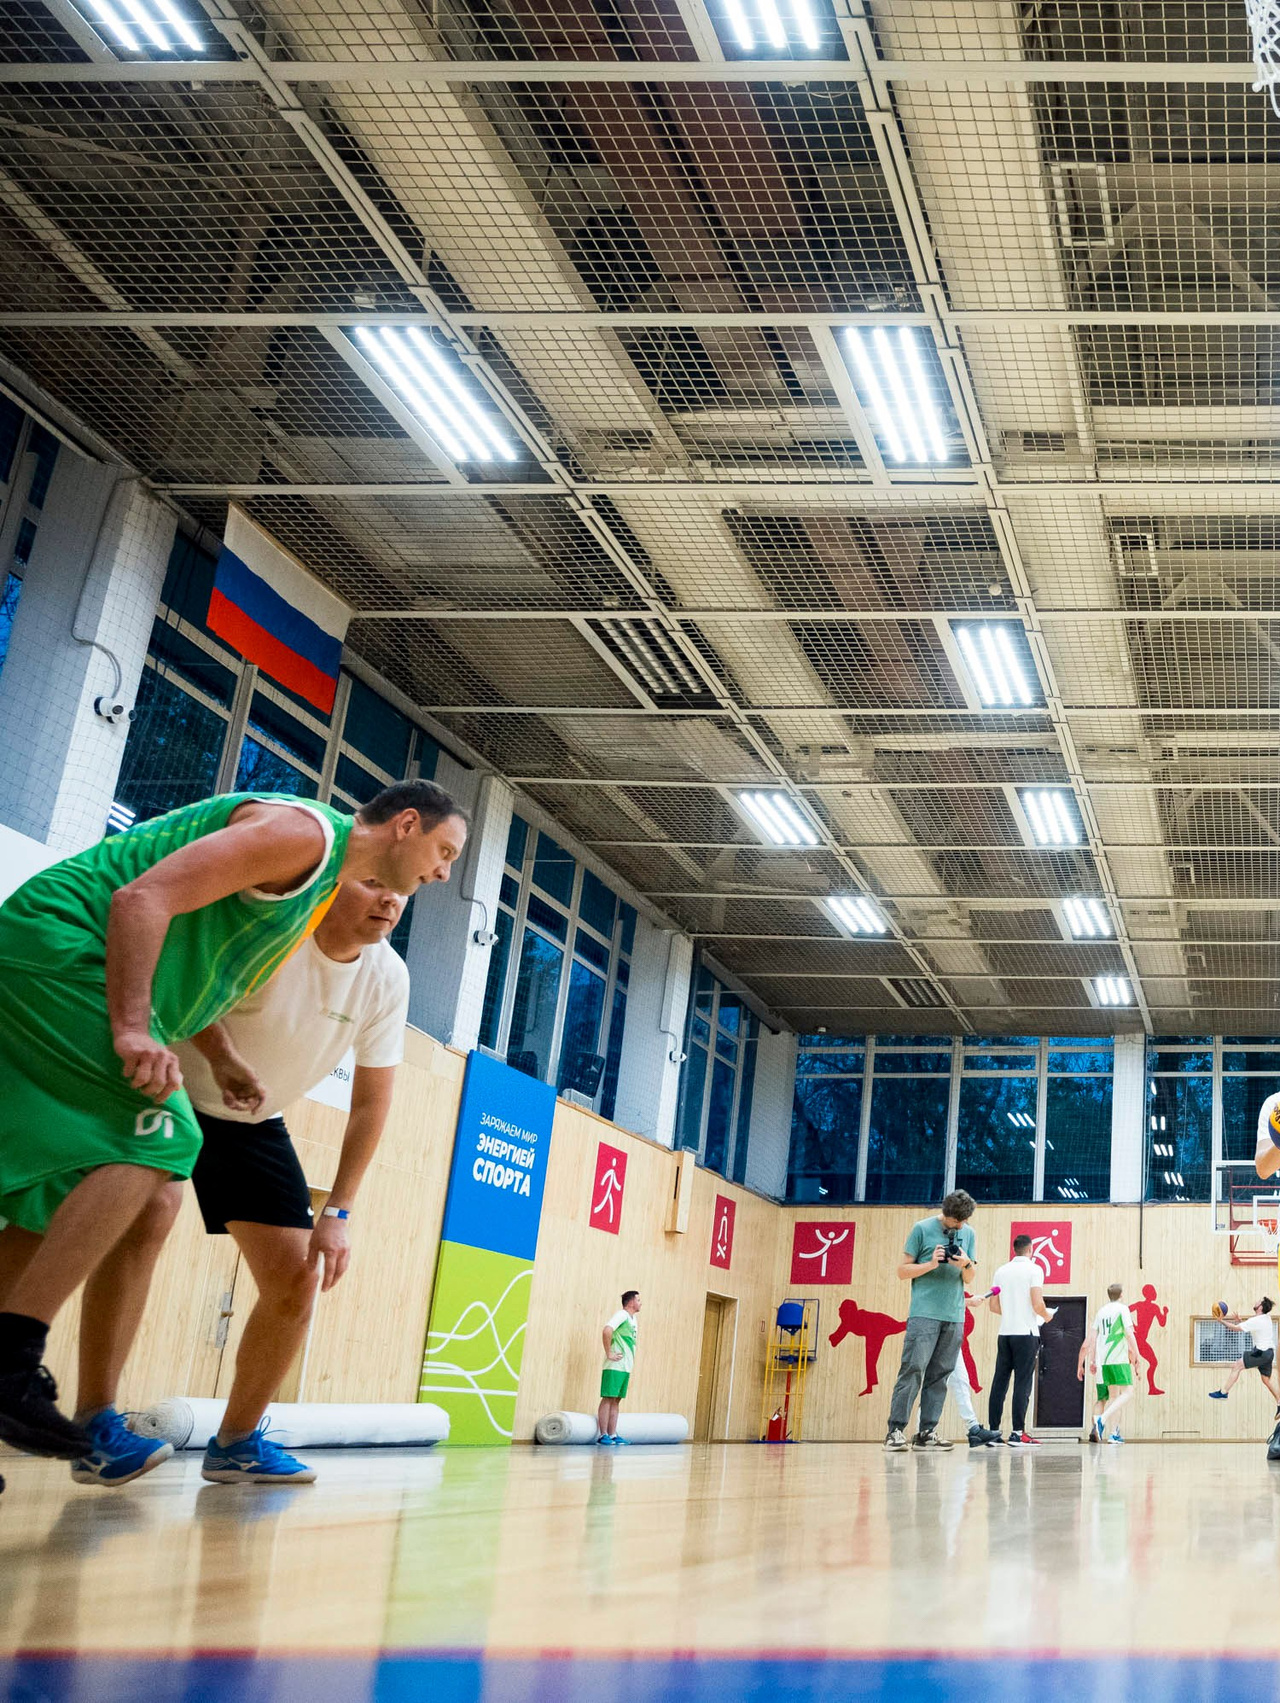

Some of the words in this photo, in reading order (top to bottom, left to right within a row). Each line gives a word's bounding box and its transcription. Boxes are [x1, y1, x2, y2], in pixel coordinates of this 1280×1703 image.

[331, 1067, 350, 1082] КВЫ
[480, 1112, 521, 1139] ЗАРЯЖАЕМ
[521, 1128, 538, 1144] МИР
[476, 1133, 535, 1169] ЭНЕРГИЕЙ
[473, 1158, 531, 1197] СПОРТА
[1102, 1317, 1111, 1335] 14
